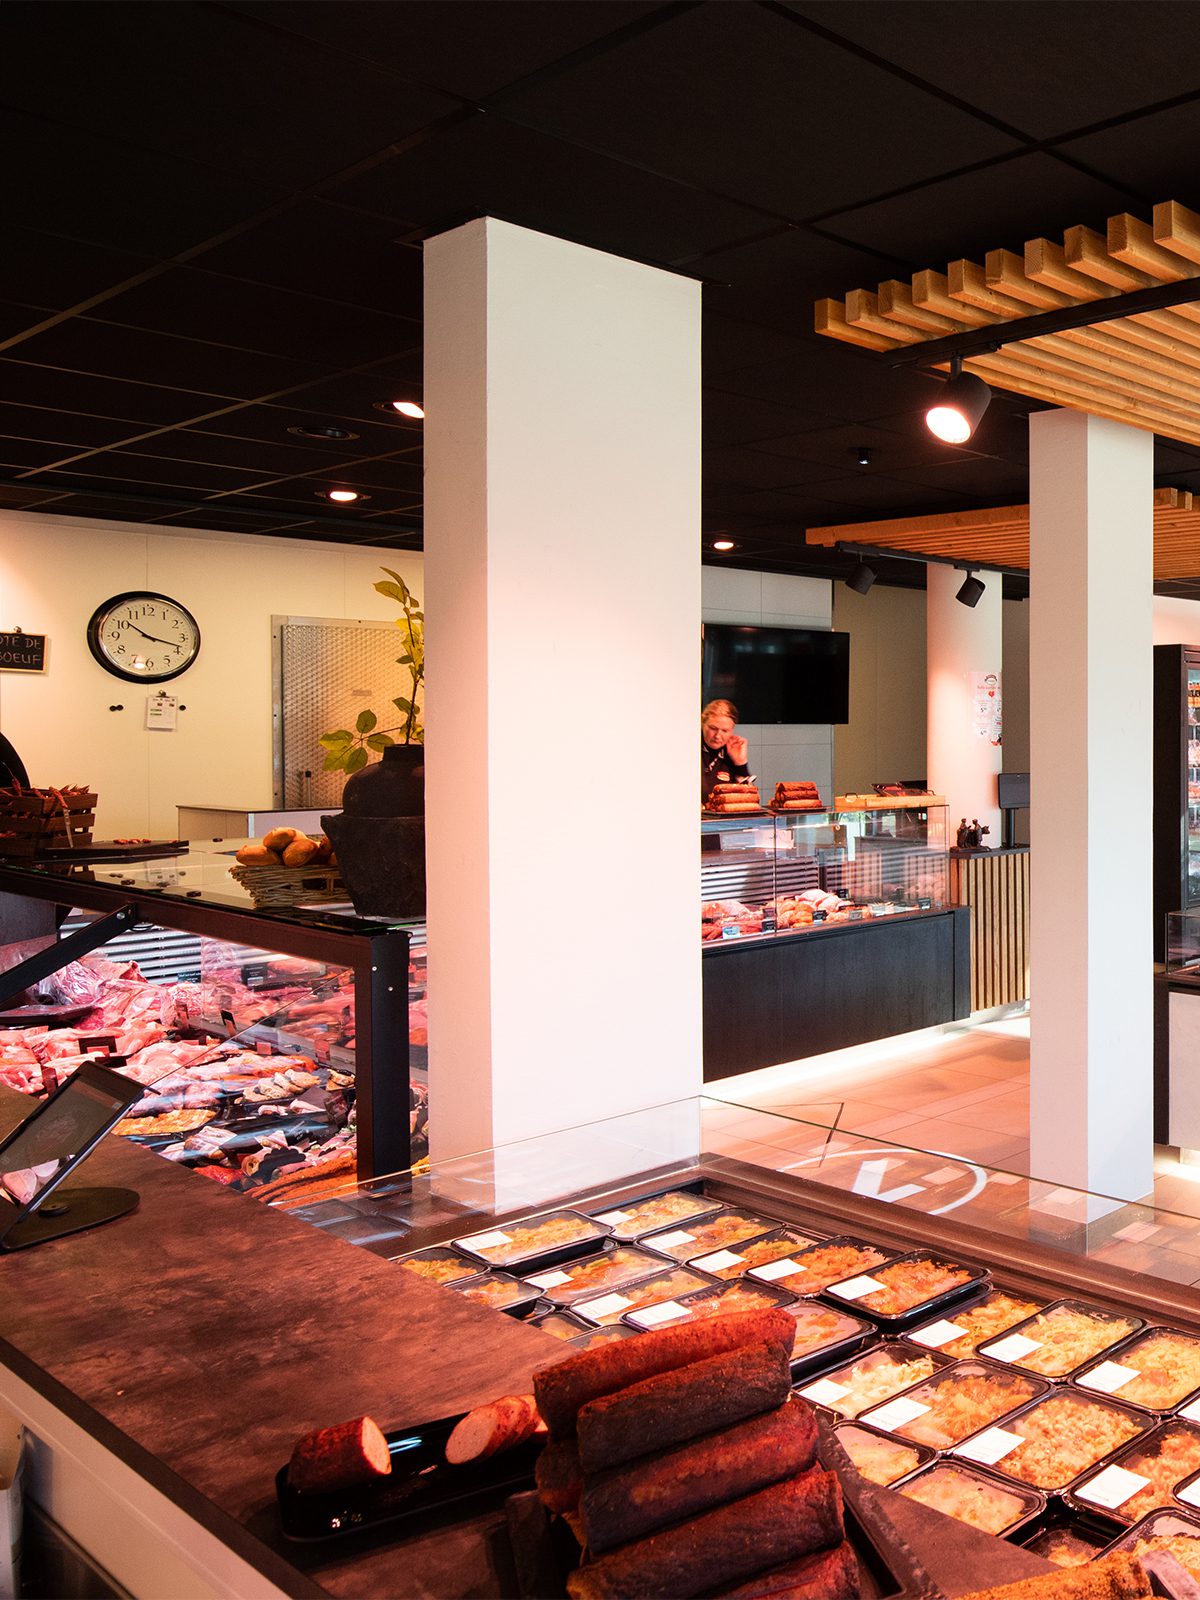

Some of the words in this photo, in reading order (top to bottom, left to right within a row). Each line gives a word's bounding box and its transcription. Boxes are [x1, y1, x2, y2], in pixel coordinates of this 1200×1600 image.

[128, 610, 139, 620] 11
[142, 606, 155, 617] 12
[162, 611, 166, 620] 1
[117, 620, 130, 630] 10
[171, 619, 179, 629] 2
[111, 630, 120, 641] 9
[179, 633, 186, 643] 3
[25, 637, 41, 650] DE
[117, 644, 126, 654] 8
[173, 645, 181, 655] 4
[131, 654, 138, 664] 7
[145, 657, 154, 668] 6
[163, 655, 171, 665] 5
